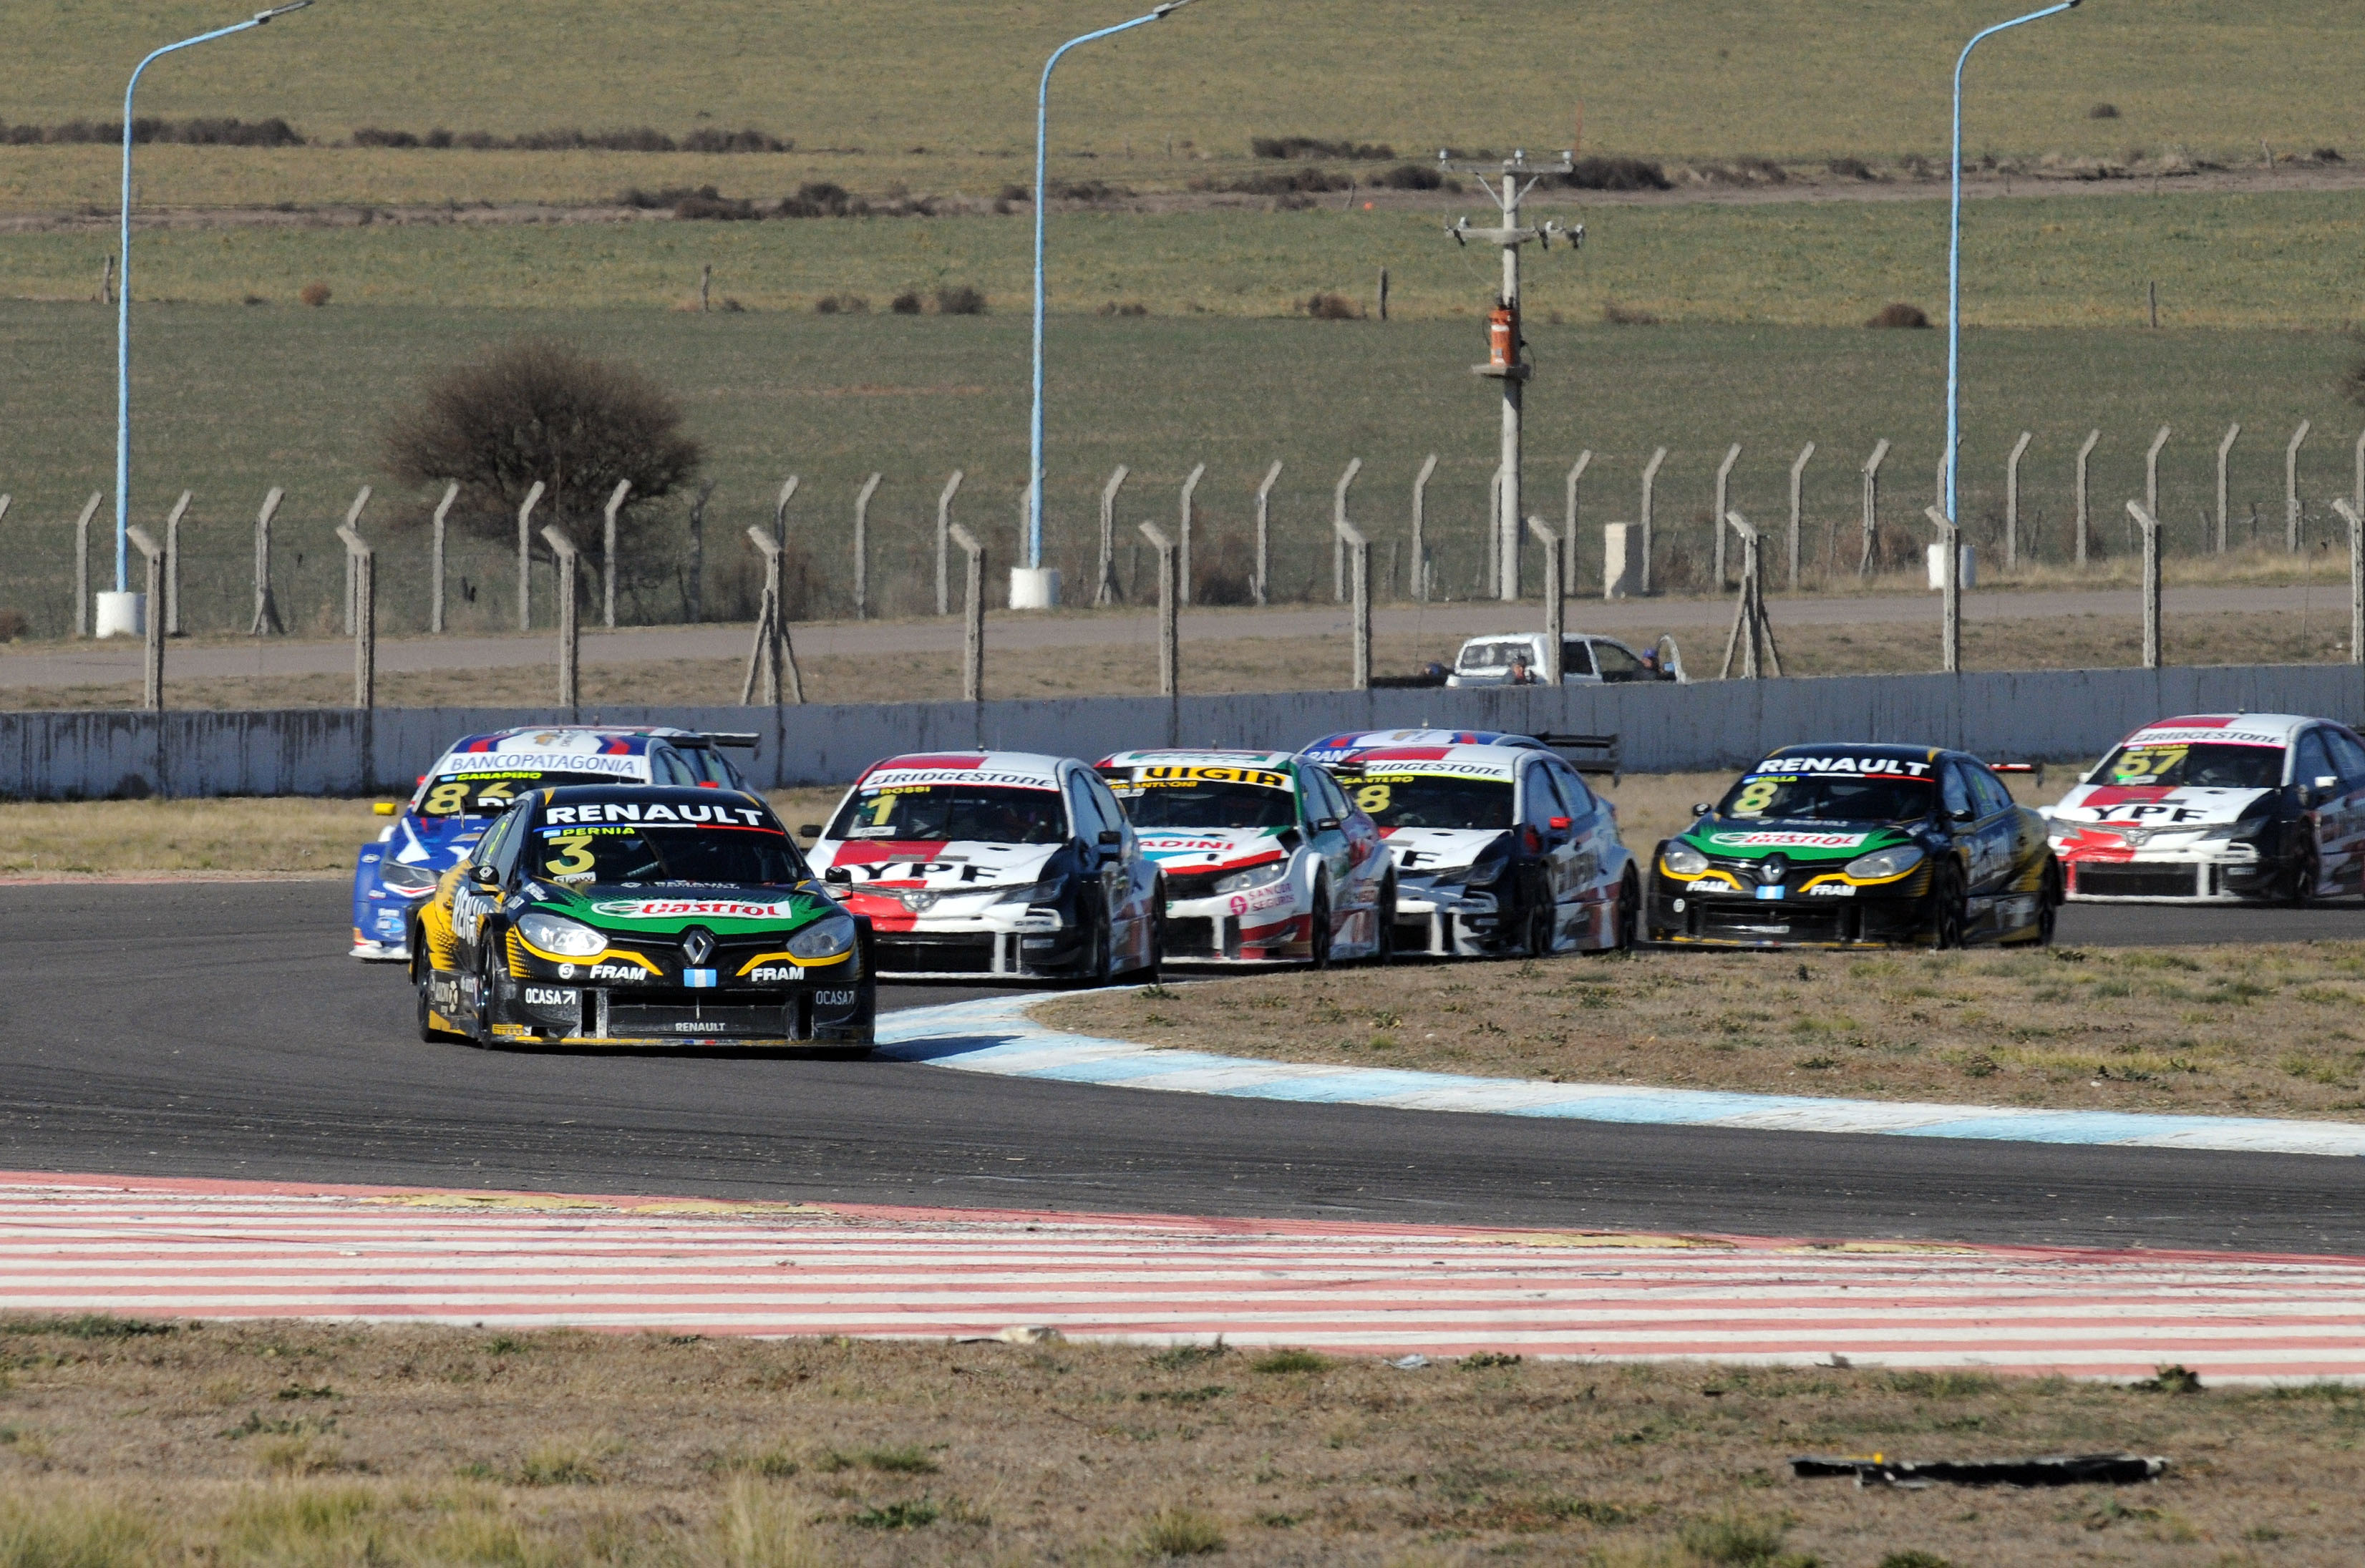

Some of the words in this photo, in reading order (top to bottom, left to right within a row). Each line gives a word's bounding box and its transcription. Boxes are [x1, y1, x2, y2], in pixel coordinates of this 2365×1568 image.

[2132, 731, 2281, 743] BRIDGESTONE
[1364, 762, 1507, 776] RIDGESTONE
[1755, 757, 1931, 775] RENAULT
[2112, 749, 2189, 776] 57
[456, 771, 543, 781] CANAPINO
[868, 771, 1055, 787] BRIDGESTONE
[1342, 776, 1414, 785] SANTERO
[880, 786, 930, 795] ROSSI
[1734, 781, 1778, 812] 8
[1344, 784, 1391, 813] 8
[545, 804, 764, 826] RENAULT
[867, 794, 897, 825] 1
[2094, 806, 2208, 822] YPF
[562, 827, 636, 837] PERNIA
[1139, 840, 1235, 850] ADINI
[545, 834, 596, 876] 3
[857, 861, 1002, 882] YPF
[1686, 881, 1730, 892] FRAM
[1809, 885, 1857, 896] FRAM
[590, 965, 648, 980] FRAM
[751, 966, 805, 982] FRAM
[675, 1022, 726, 1032] RENAULT
